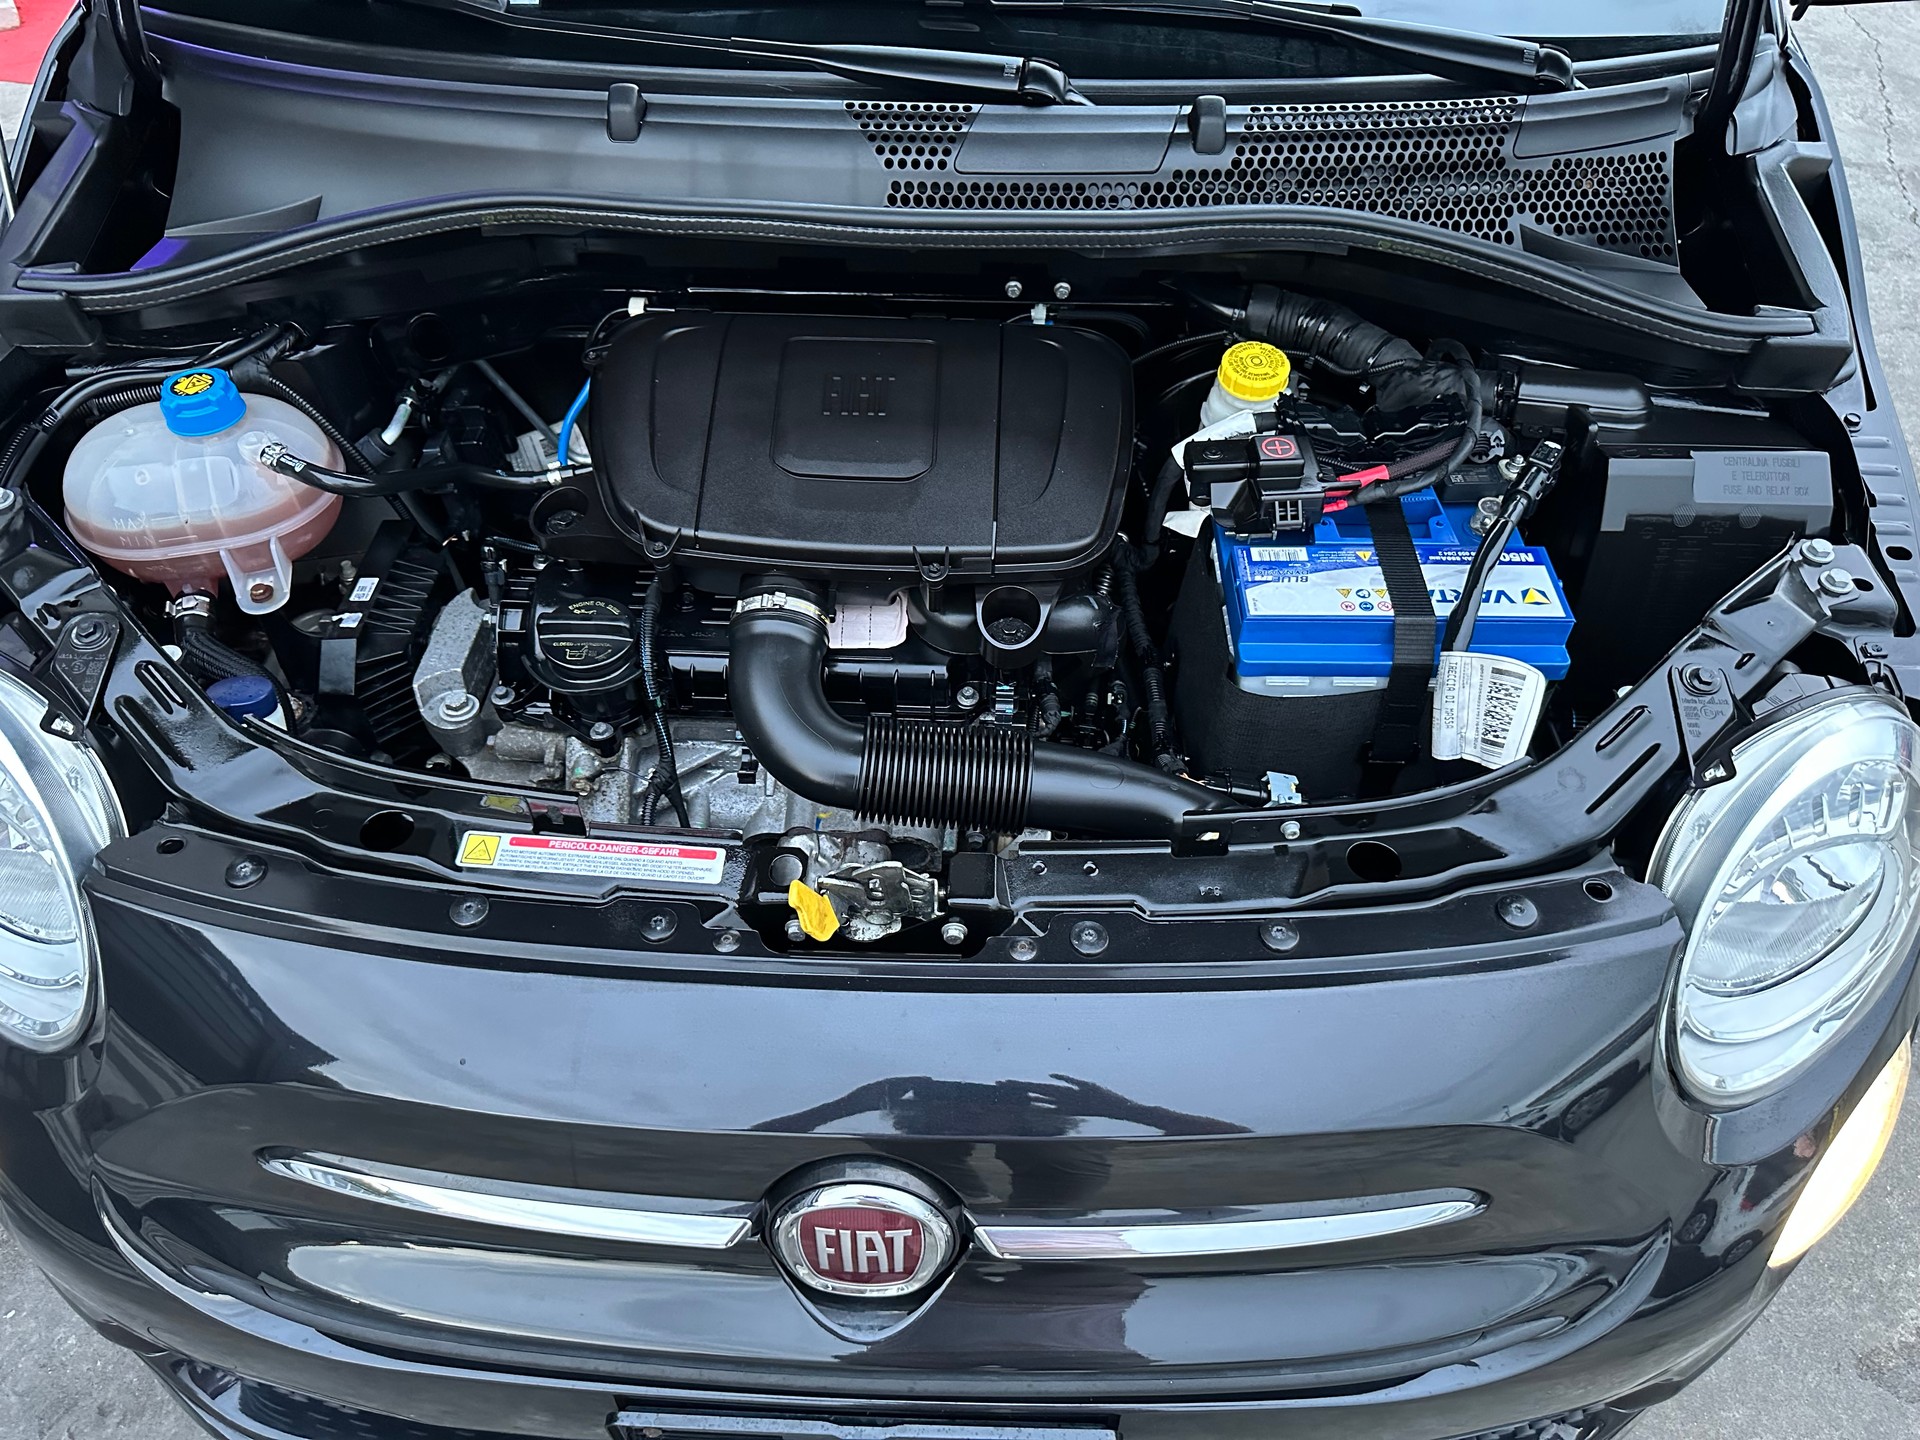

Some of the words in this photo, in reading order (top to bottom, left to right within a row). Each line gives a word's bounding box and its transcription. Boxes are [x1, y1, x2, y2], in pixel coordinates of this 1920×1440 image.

[1723, 456, 1768, 466] CENTRALINA
[1732, 471, 1737, 481] E
[1722, 486, 1742, 495] FUSE
[1746, 486, 1762, 496] AND
[1766, 486, 1790, 496] RELAY
[1794, 486, 1809, 496] BOX
[120, 535, 156, 547] MIN
[568, 600, 594, 610] ENGINE
[1446, 662, 1458, 692] TRECCIA
[1445, 695, 1455, 704] DI
[548, 840, 679, 856] PERICOLO-DANGER-GEFAHR
[814, 1226, 912, 1273] FIAT
